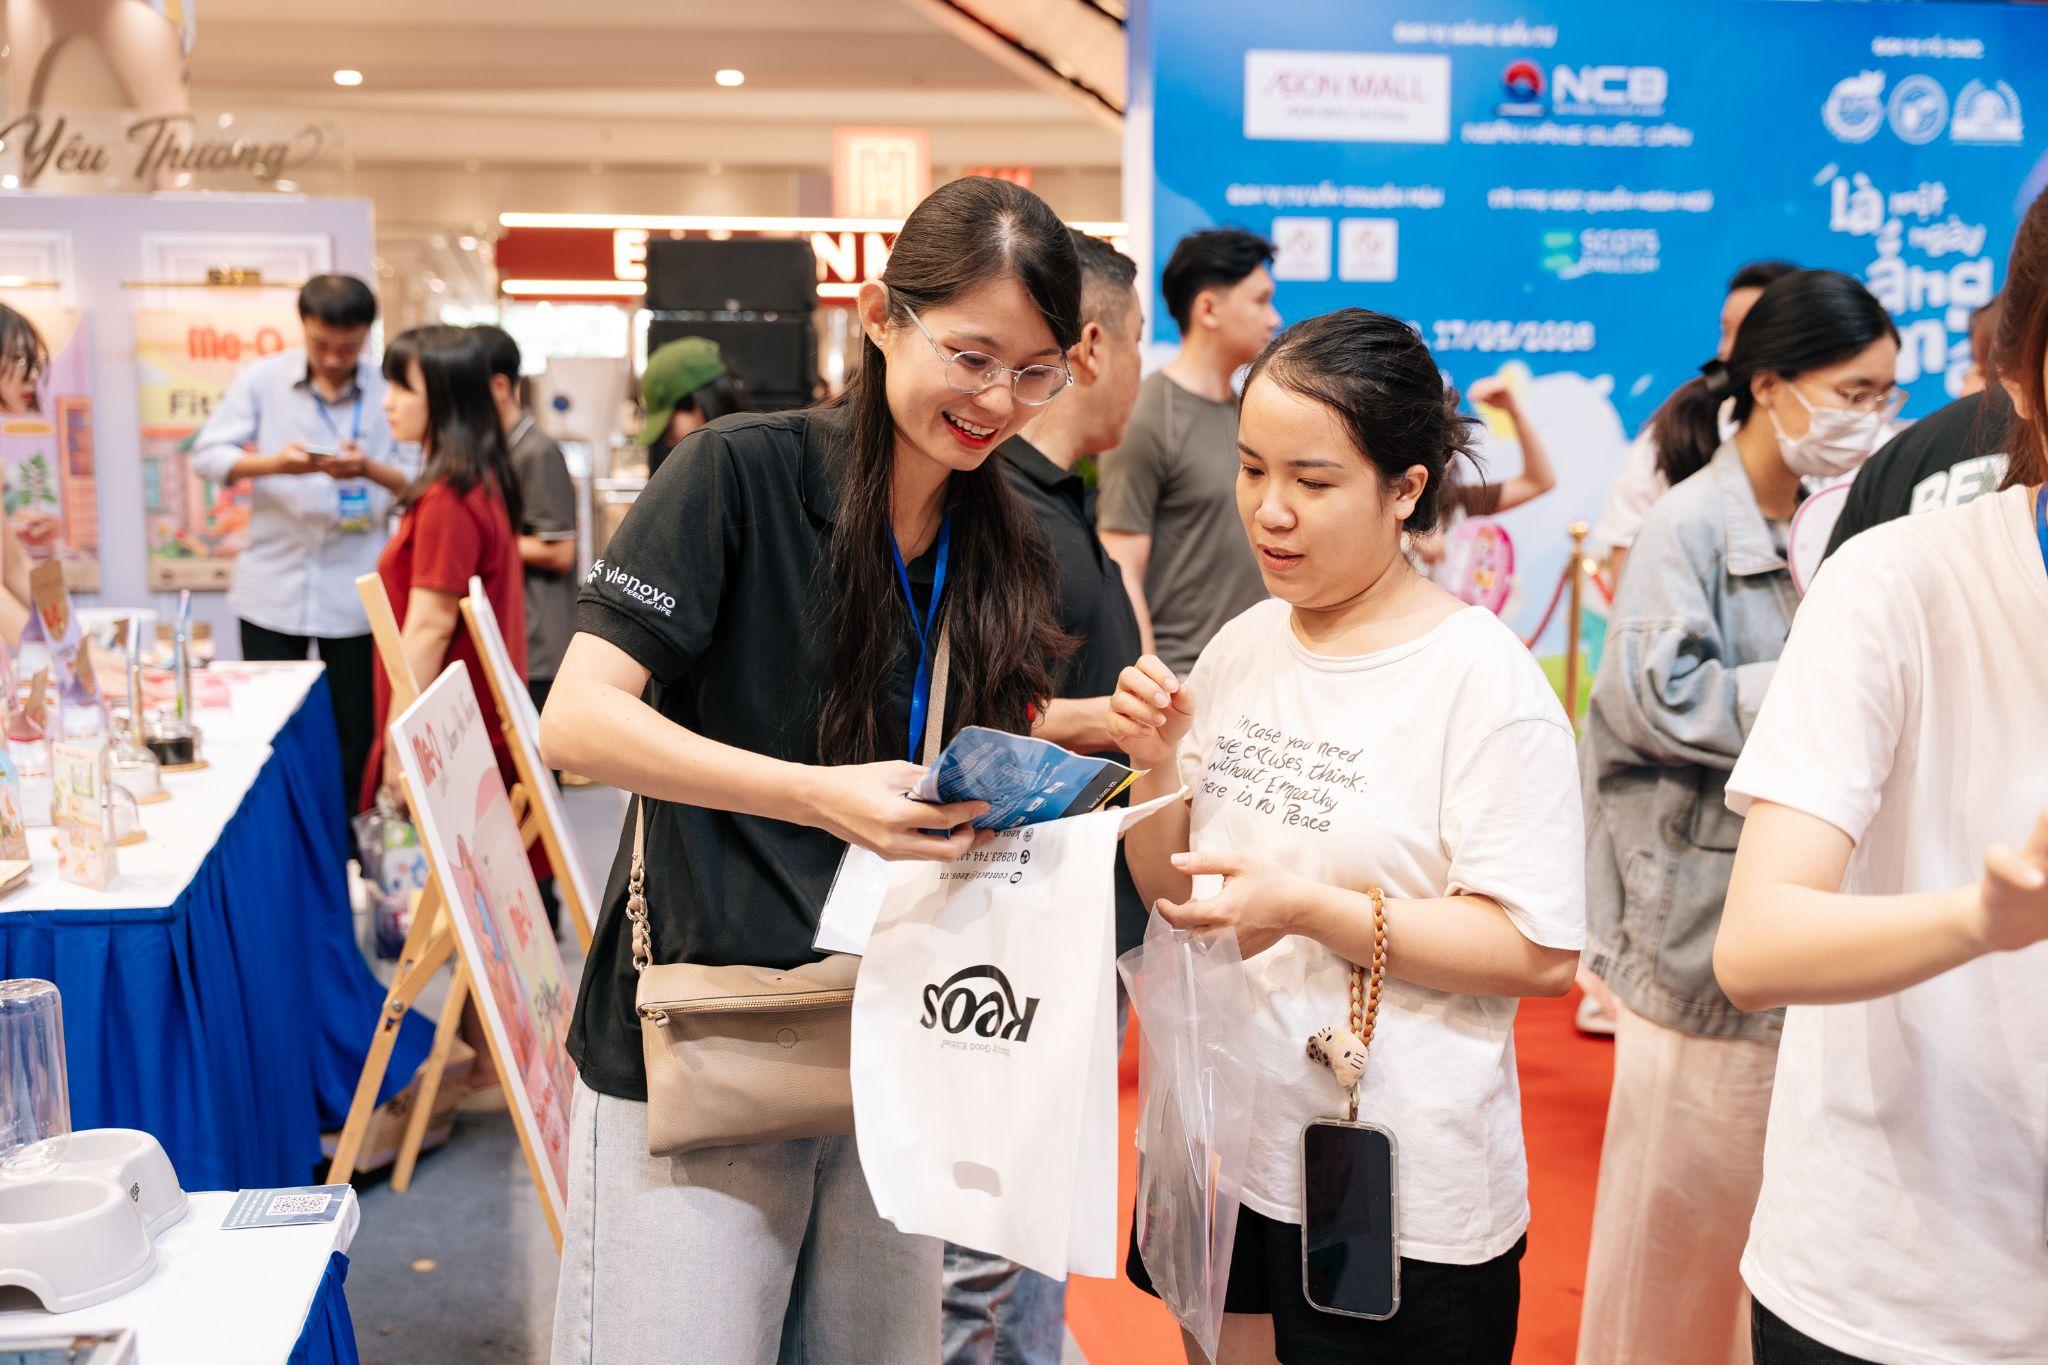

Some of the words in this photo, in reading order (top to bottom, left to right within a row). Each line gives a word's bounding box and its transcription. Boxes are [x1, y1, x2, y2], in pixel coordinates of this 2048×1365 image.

[1552, 64, 1668, 106] NCB
[1234, 785, 1251, 807] is
[1282, 804, 1331, 832] Peace
